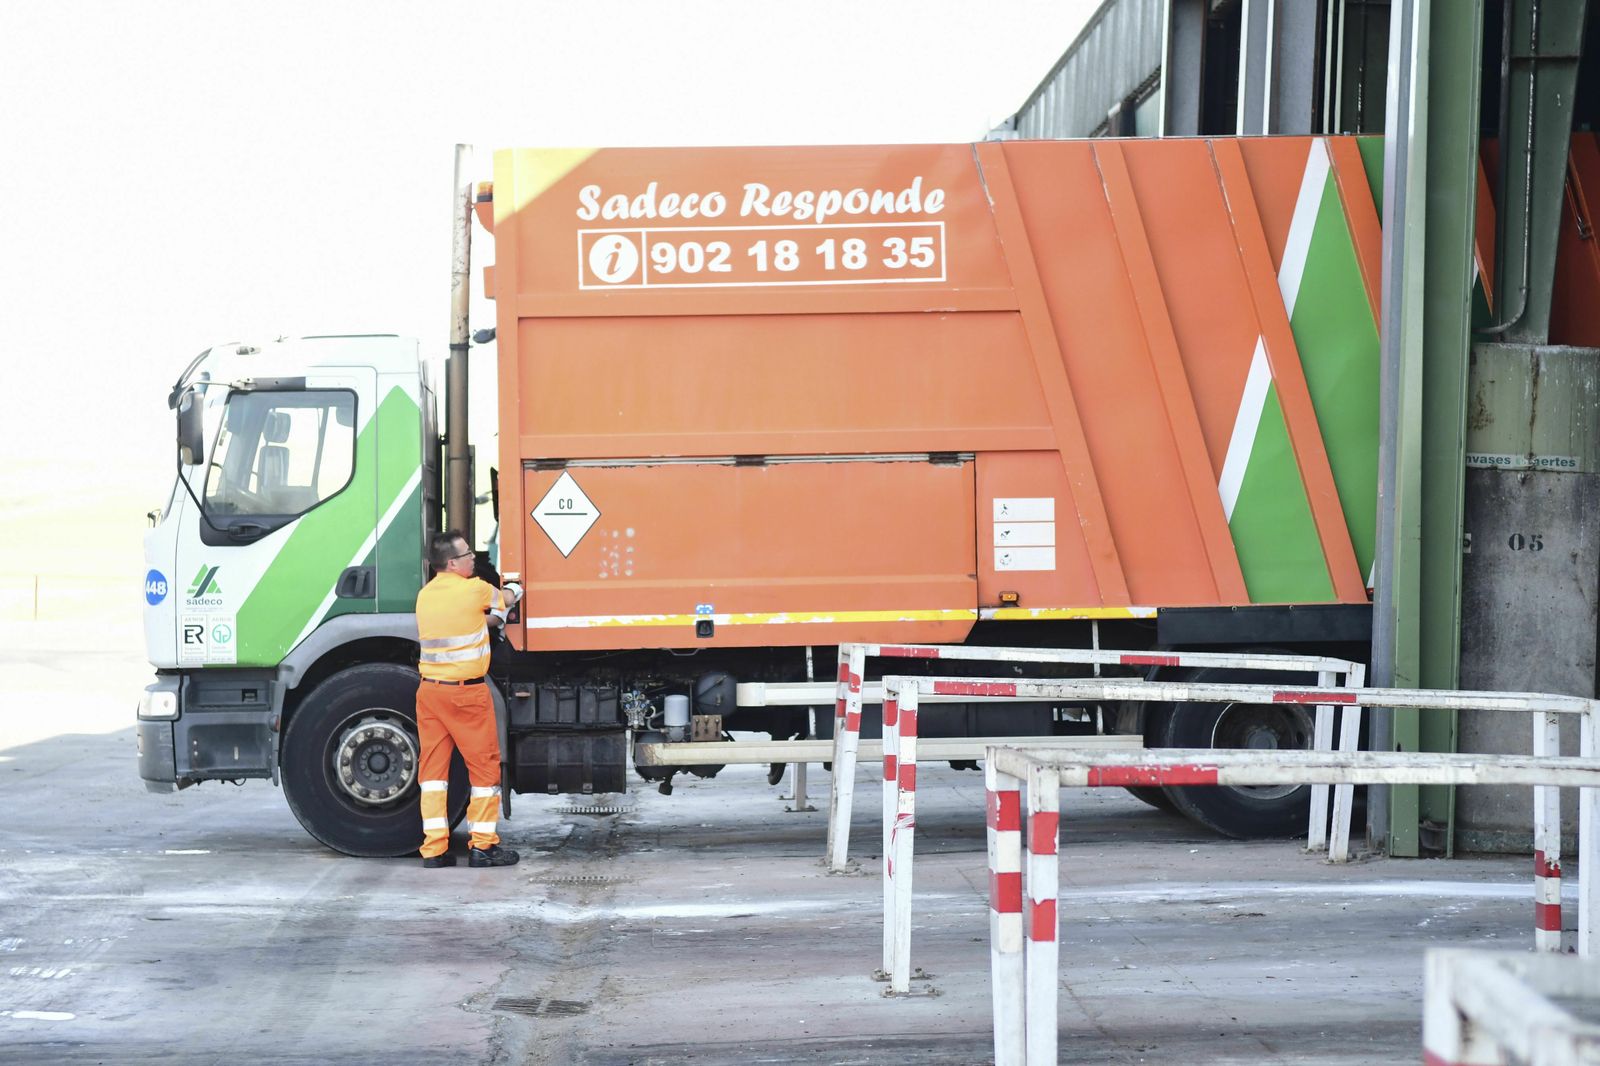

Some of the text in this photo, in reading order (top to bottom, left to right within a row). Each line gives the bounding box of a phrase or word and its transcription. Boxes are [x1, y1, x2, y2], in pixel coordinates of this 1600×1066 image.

[577, 176, 945, 223] Sadeco Responde
[651, 241, 732, 274] 902
[747, 240, 799, 272] 18
[815, 238, 868, 270] 18
[882, 236, 936, 269] 35
[1508, 533, 1544, 552] 05
[186, 597, 223, 606] sadeco
[184, 624, 204, 644] ER
